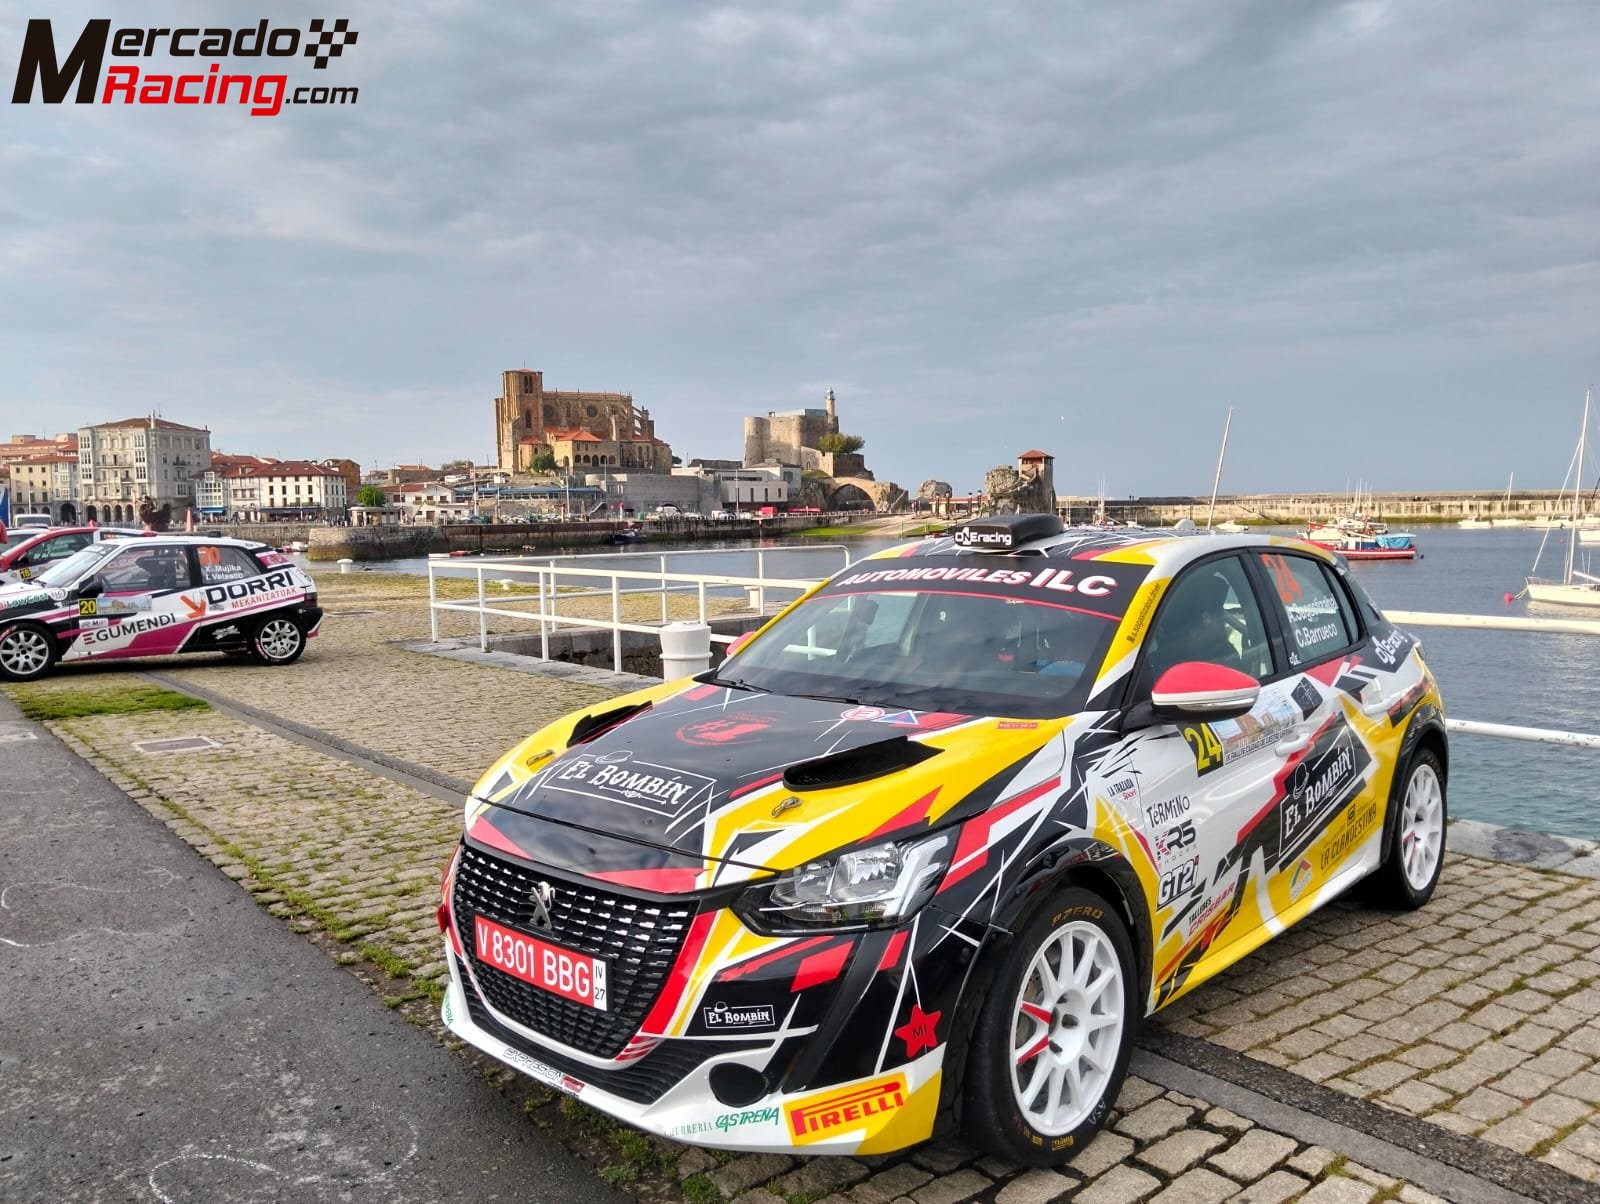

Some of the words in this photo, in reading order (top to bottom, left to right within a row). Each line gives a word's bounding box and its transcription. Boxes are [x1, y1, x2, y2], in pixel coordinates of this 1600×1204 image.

[205, 570, 294, 605] DORRI
[835, 567, 1034, 588] AUTOMOVILES
[1029, 567, 1119, 597] ILC
[1260, 552, 1304, 603] 24
[80, 600, 97, 614] 20
[231, 587, 297, 609] MEKANIZATUAK
[82, 612, 176, 646] EGUMENDI
[1183, 722, 1222, 770] 24
[557, 760, 595, 780] EL
[1284, 803, 1302, 840] EL
[477, 921, 488, 957] V
[492, 930, 535, 979] 8301
[543, 949, 590, 998] BBG
[595, 965, 603, 979] IV
[594, 987, 605, 1000] 27
[707, 1011, 722, 1024] EL
[791, 1081, 904, 1137] PIRELLI
